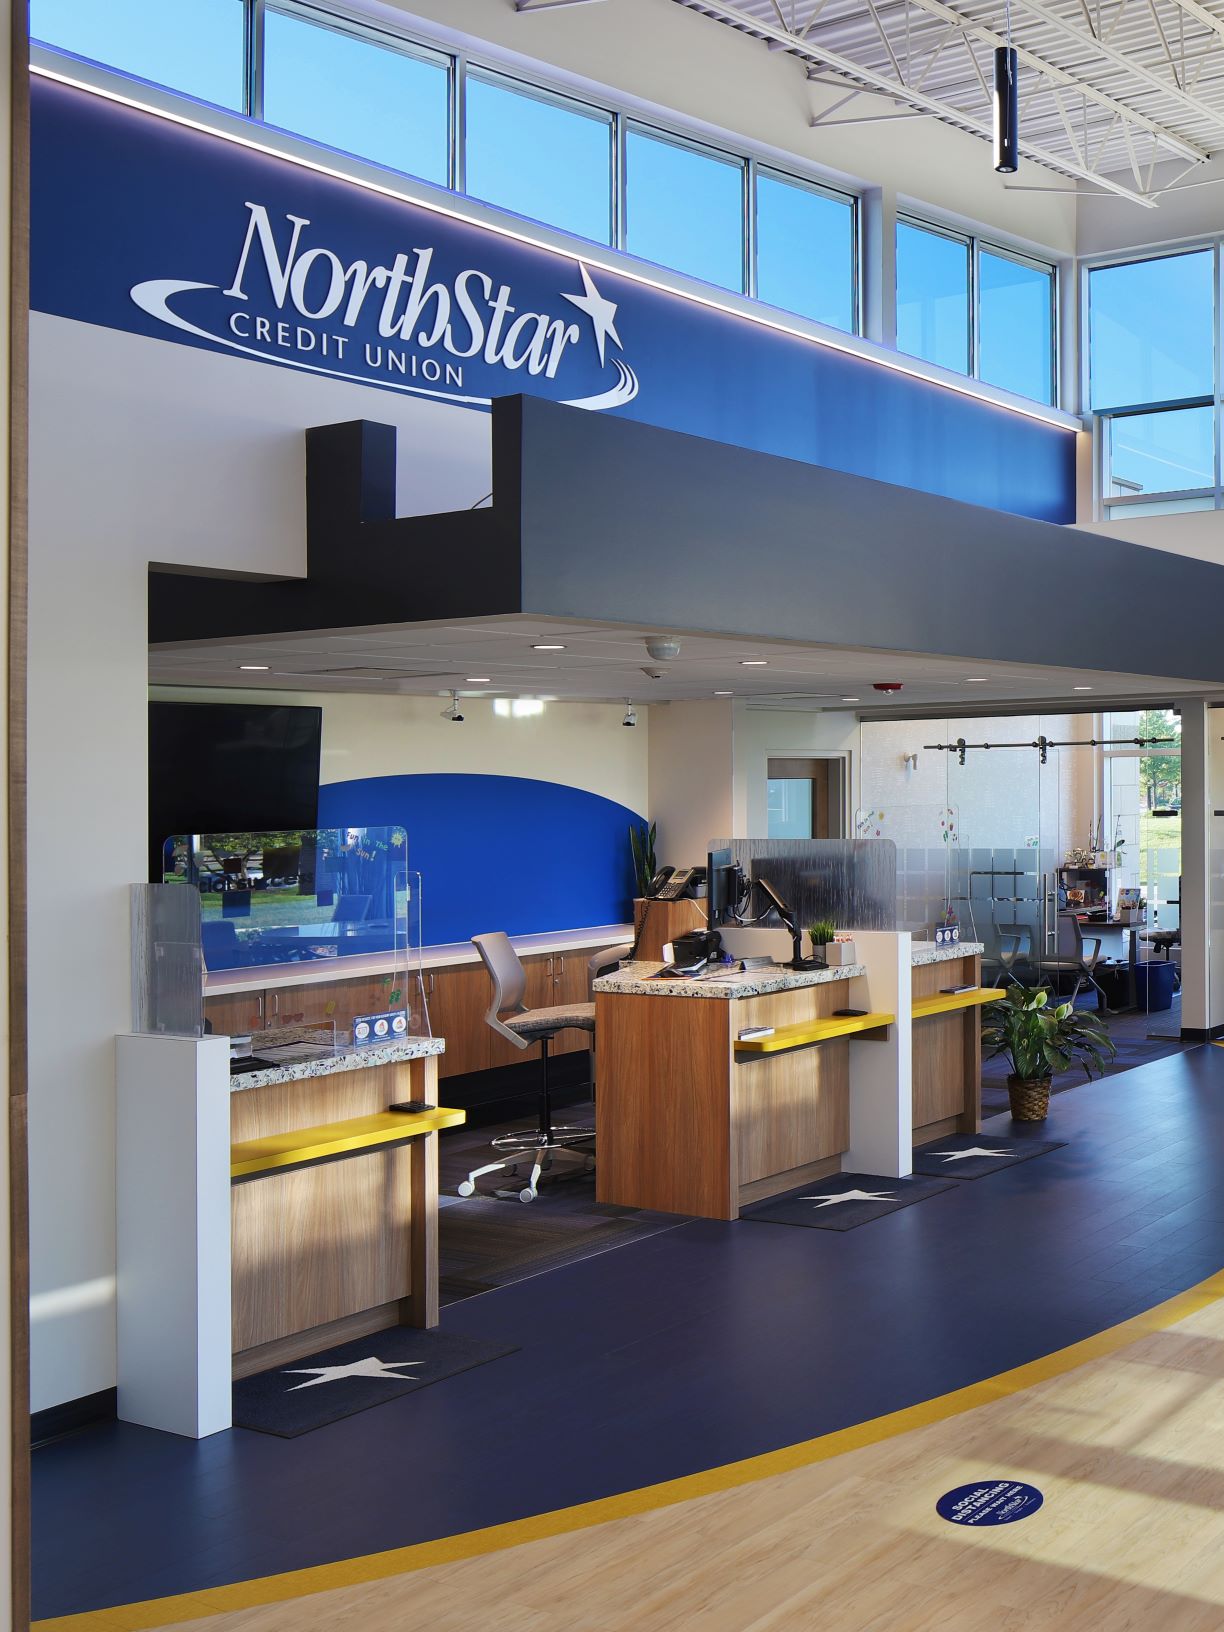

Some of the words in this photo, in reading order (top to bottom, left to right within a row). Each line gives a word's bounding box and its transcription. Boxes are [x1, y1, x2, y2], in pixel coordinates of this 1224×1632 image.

[223, 201, 580, 379] NorthStar
[229, 312, 349, 360] CREDIT
[365, 343, 464, 387] UNION
[951, 1488, 989, 1512] SOCIAL
[951, 1482, 1010, 1521] DISTANCING
